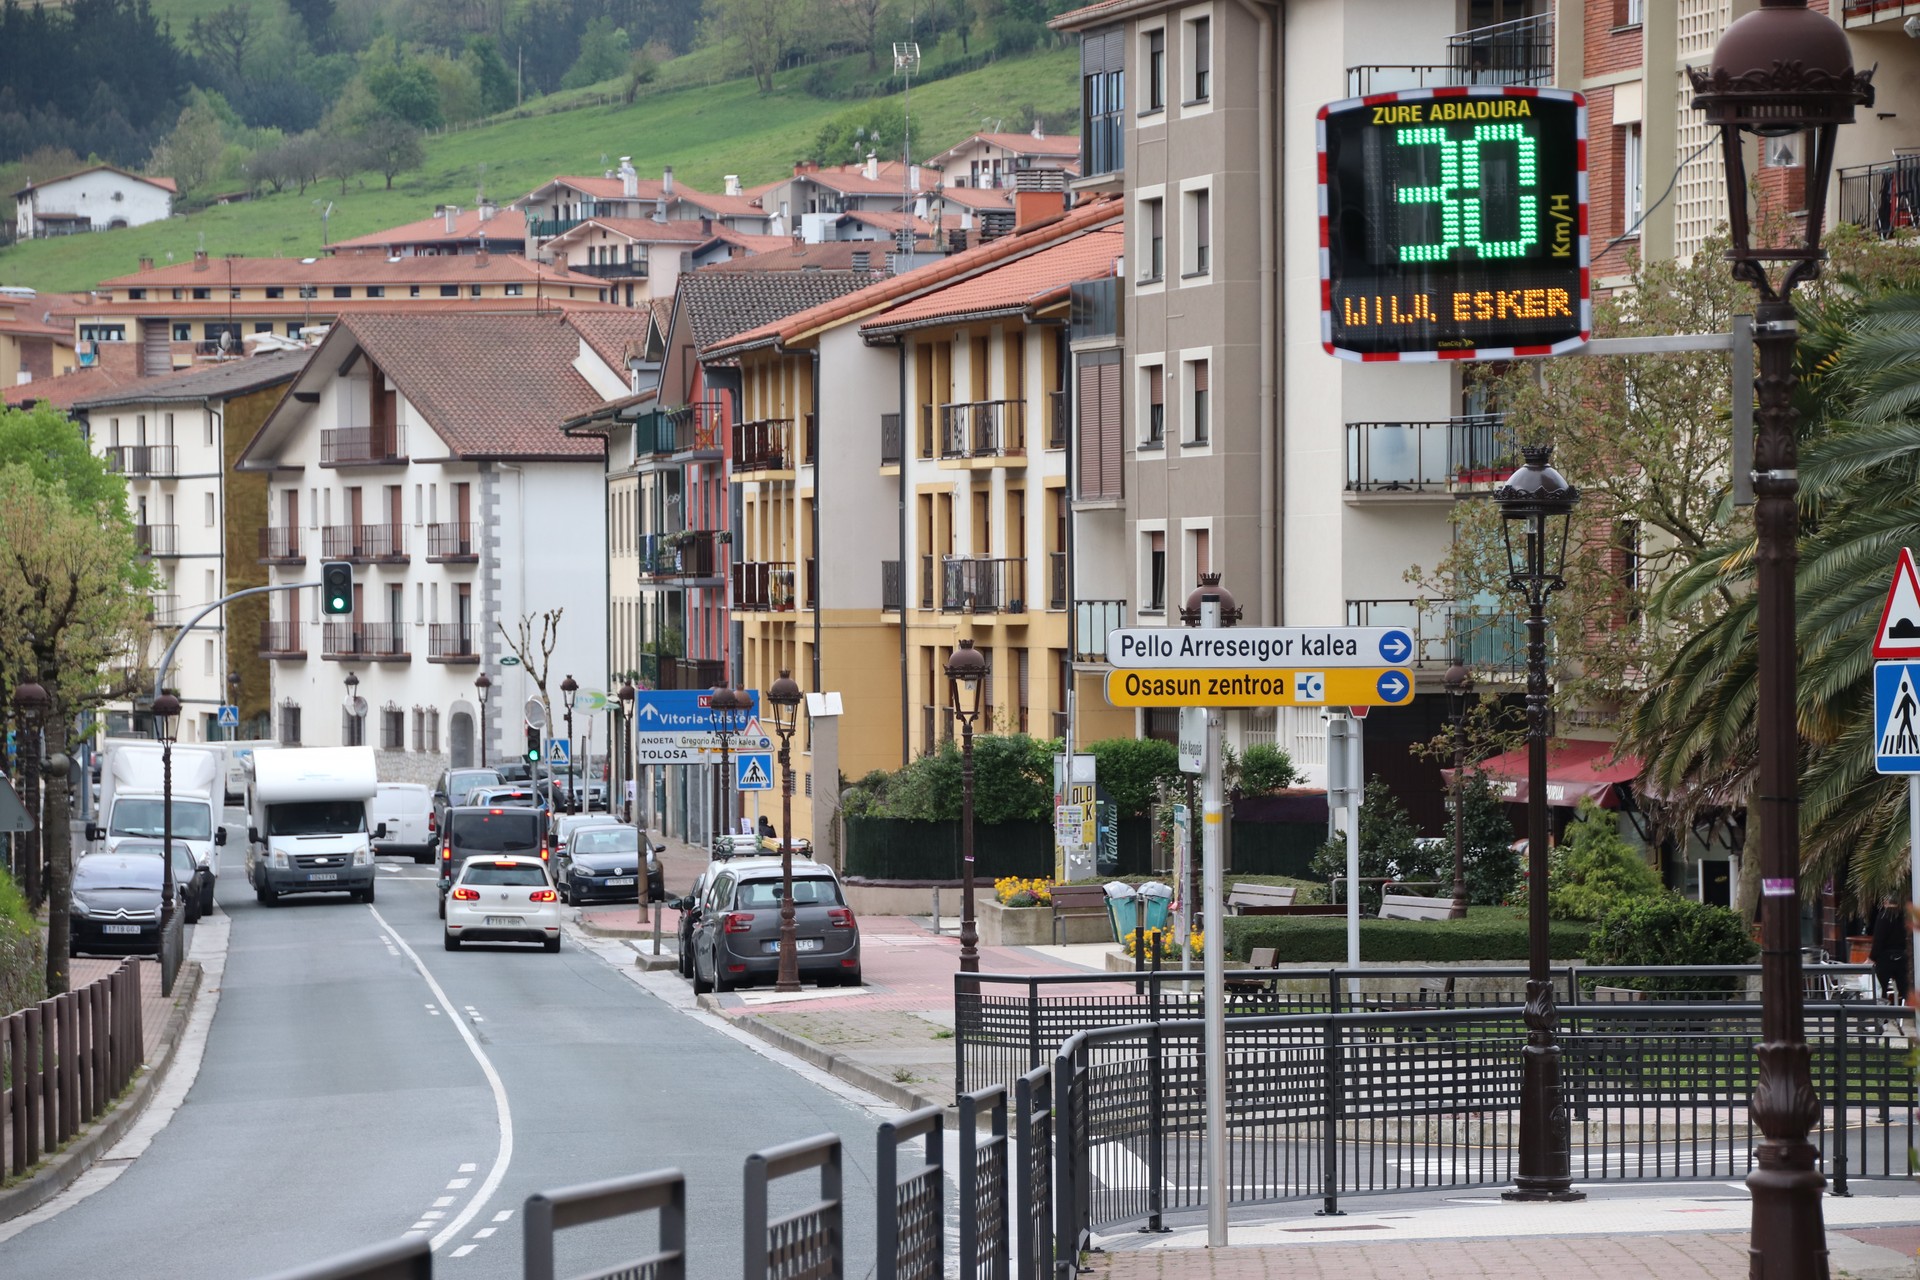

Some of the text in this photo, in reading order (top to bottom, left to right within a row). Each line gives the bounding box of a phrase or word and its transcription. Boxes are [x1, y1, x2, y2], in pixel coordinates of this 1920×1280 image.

[1372, 100, 1531, 124] ZURE ABIADURA
[1396, 123, 1537, 262] 30
[1550, 194, 1574, 258] Km/H
[1453, 287, 1573, 322] ESKER
[1121, 634, 1173, 657] Pello
[1301, 633, 1357, 656] kalea
[1125, 673, 1284, 697] Osasun zentroa
[681, 736, 710, 747] Gregorio
[738, 736, 756, 746] kalea
[641, 750, 688, 759] TOLOSA
